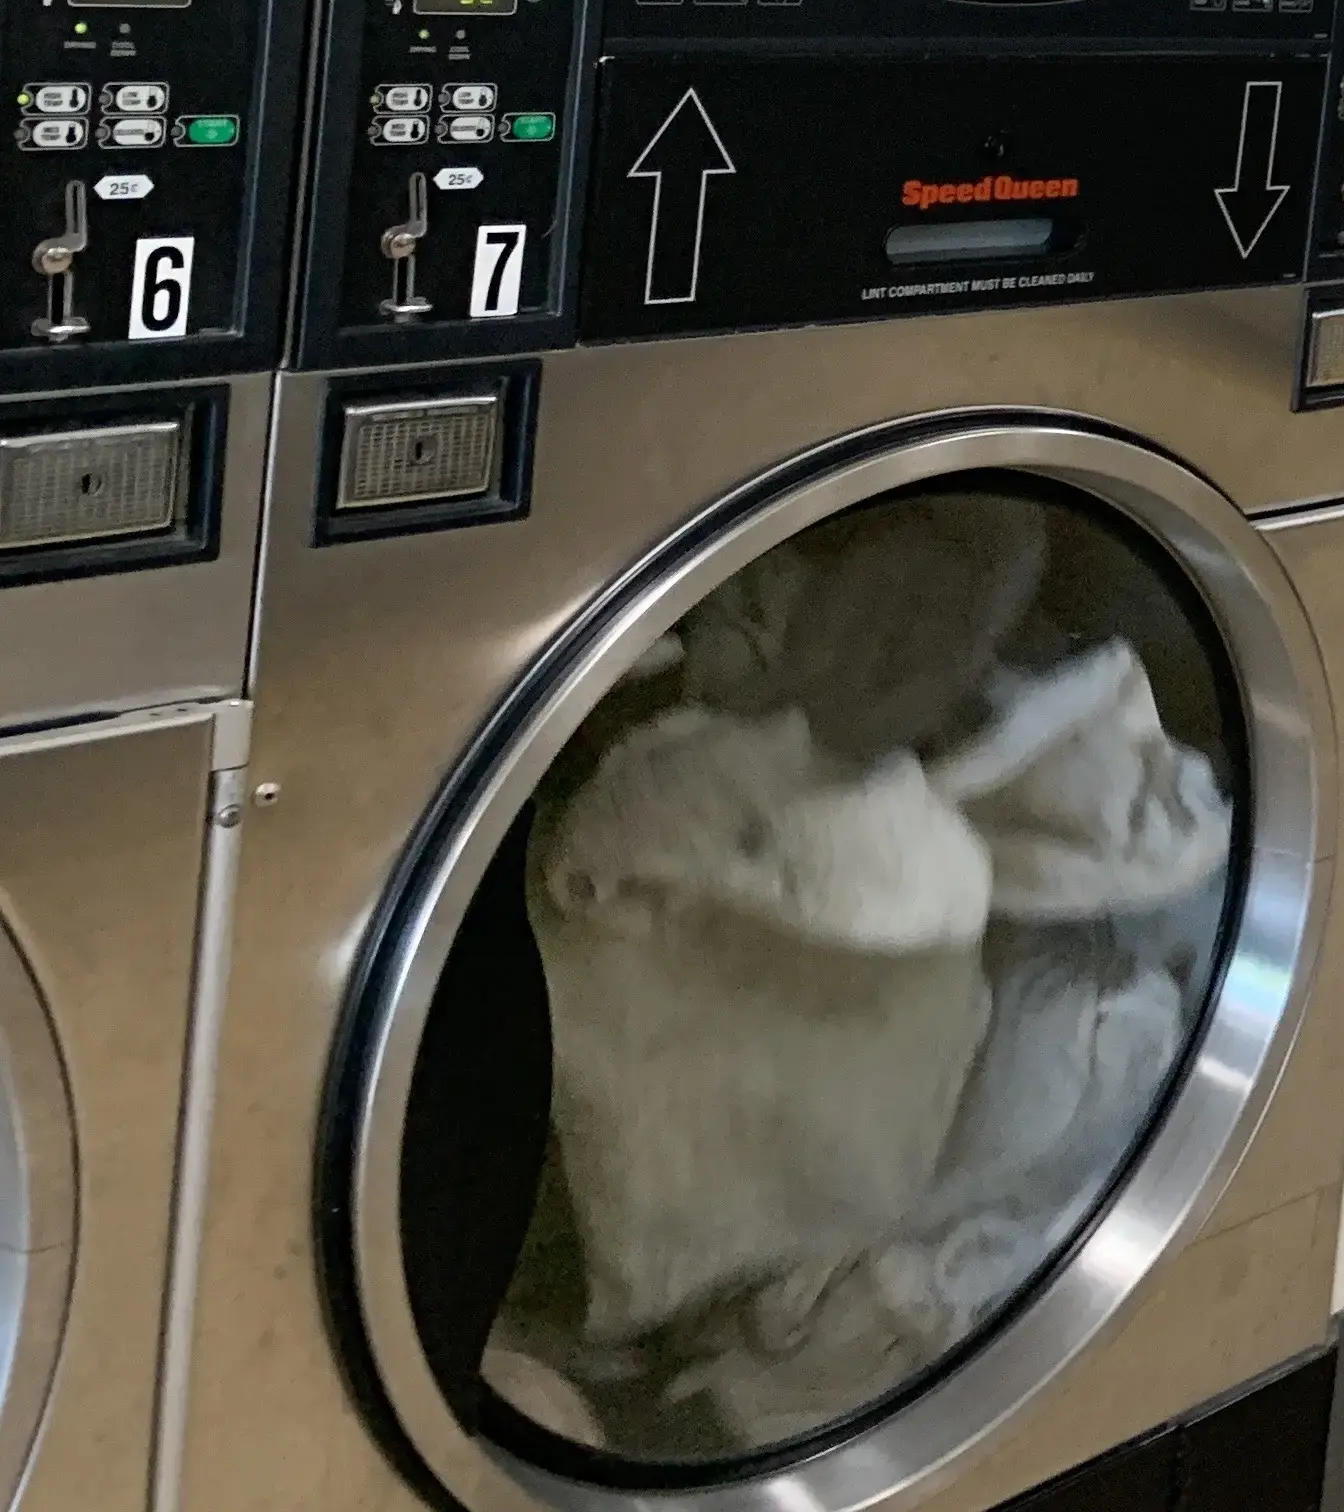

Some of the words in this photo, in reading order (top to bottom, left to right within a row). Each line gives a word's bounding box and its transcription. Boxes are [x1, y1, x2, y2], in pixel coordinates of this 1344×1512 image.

[903, 176, 992, 210] Speed
[994, 175, 1080, 201] Queen
[140, 245, 184, 333] 6
[483, 231, 521, 313] 7
[889, 280, 969, 298] COMPARTMENT
[971, 277, 1000, 292] MUST
[1002, 277, 1016, 289] BE
